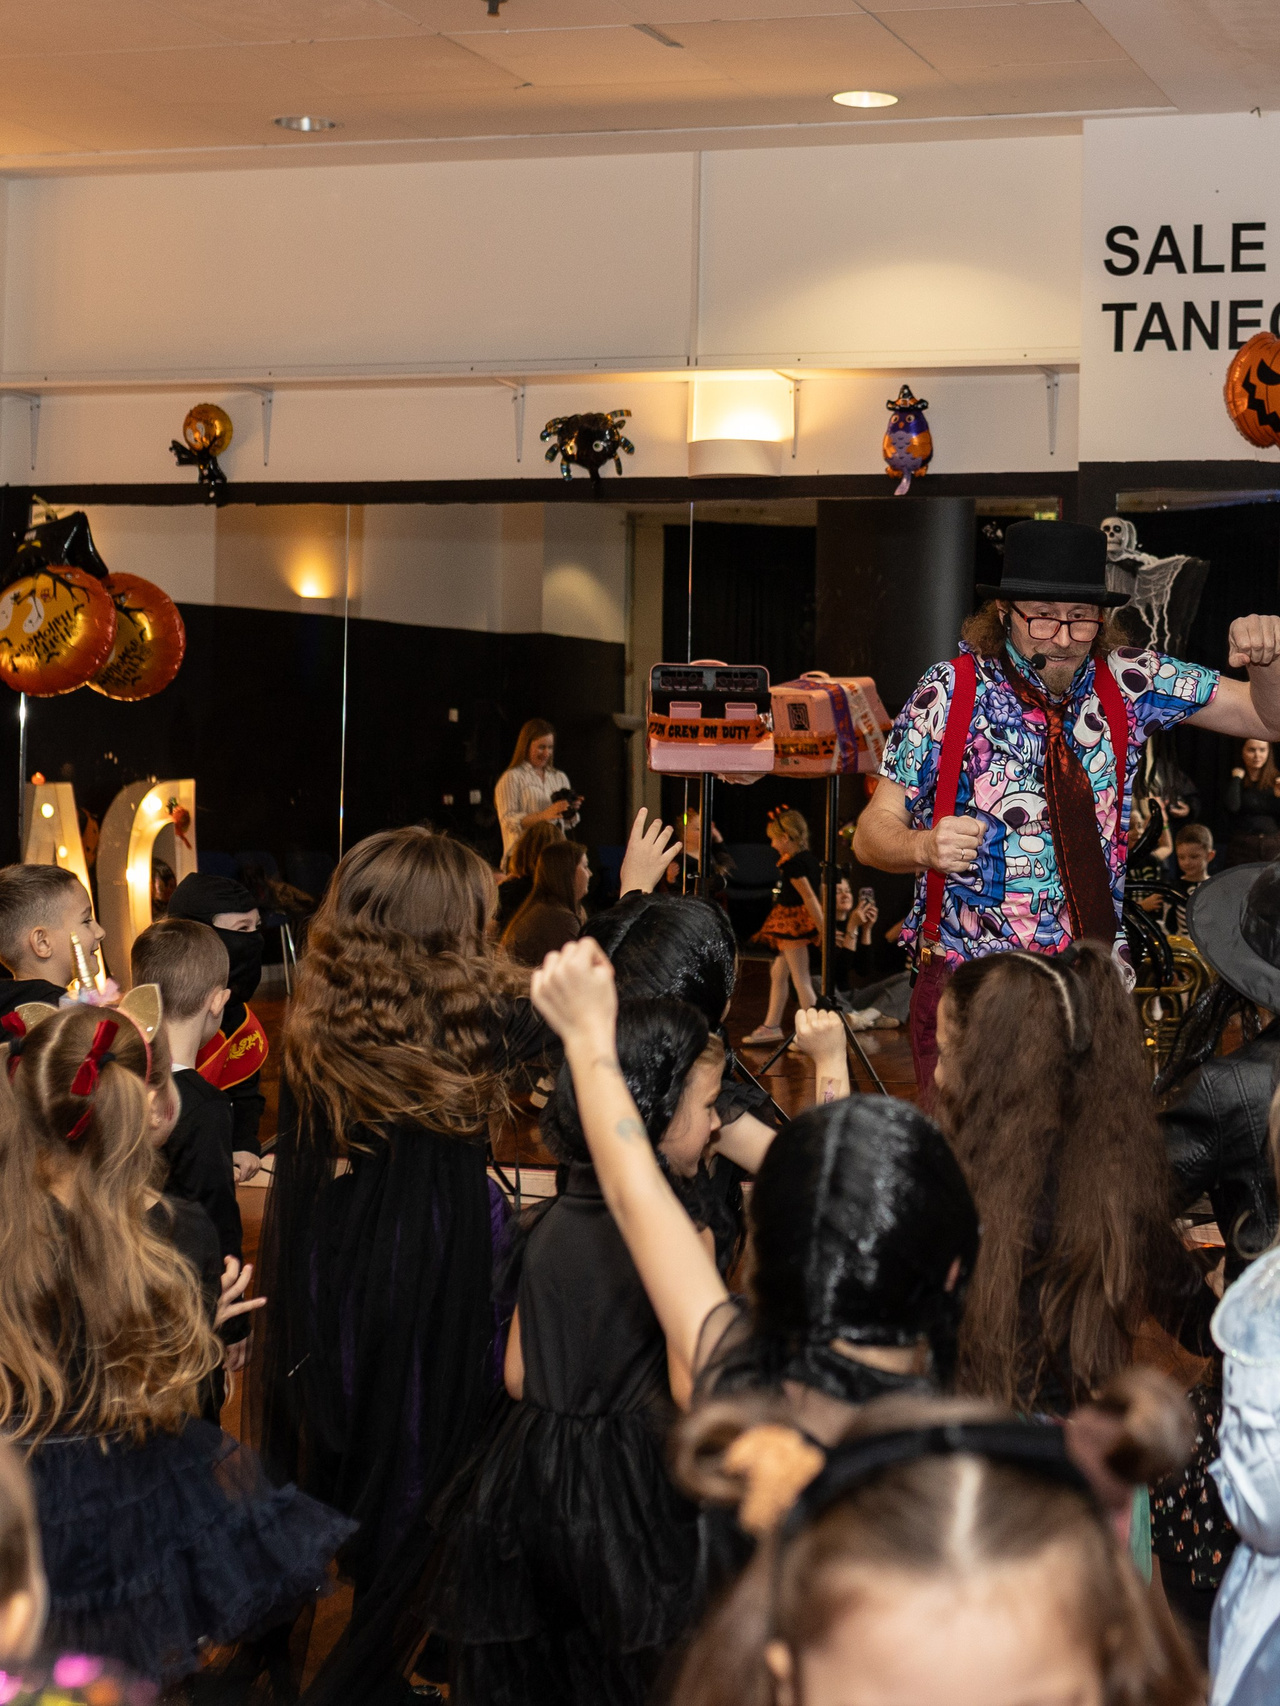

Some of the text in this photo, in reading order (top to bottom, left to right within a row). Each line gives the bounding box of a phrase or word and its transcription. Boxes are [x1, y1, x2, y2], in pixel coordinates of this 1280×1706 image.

[1103, 222, 1266, 276] SALE
[668, 725, 699, 739] CREW
[703, 725, 718, 738] ON
[722, 726, 750, 739] DUTY
